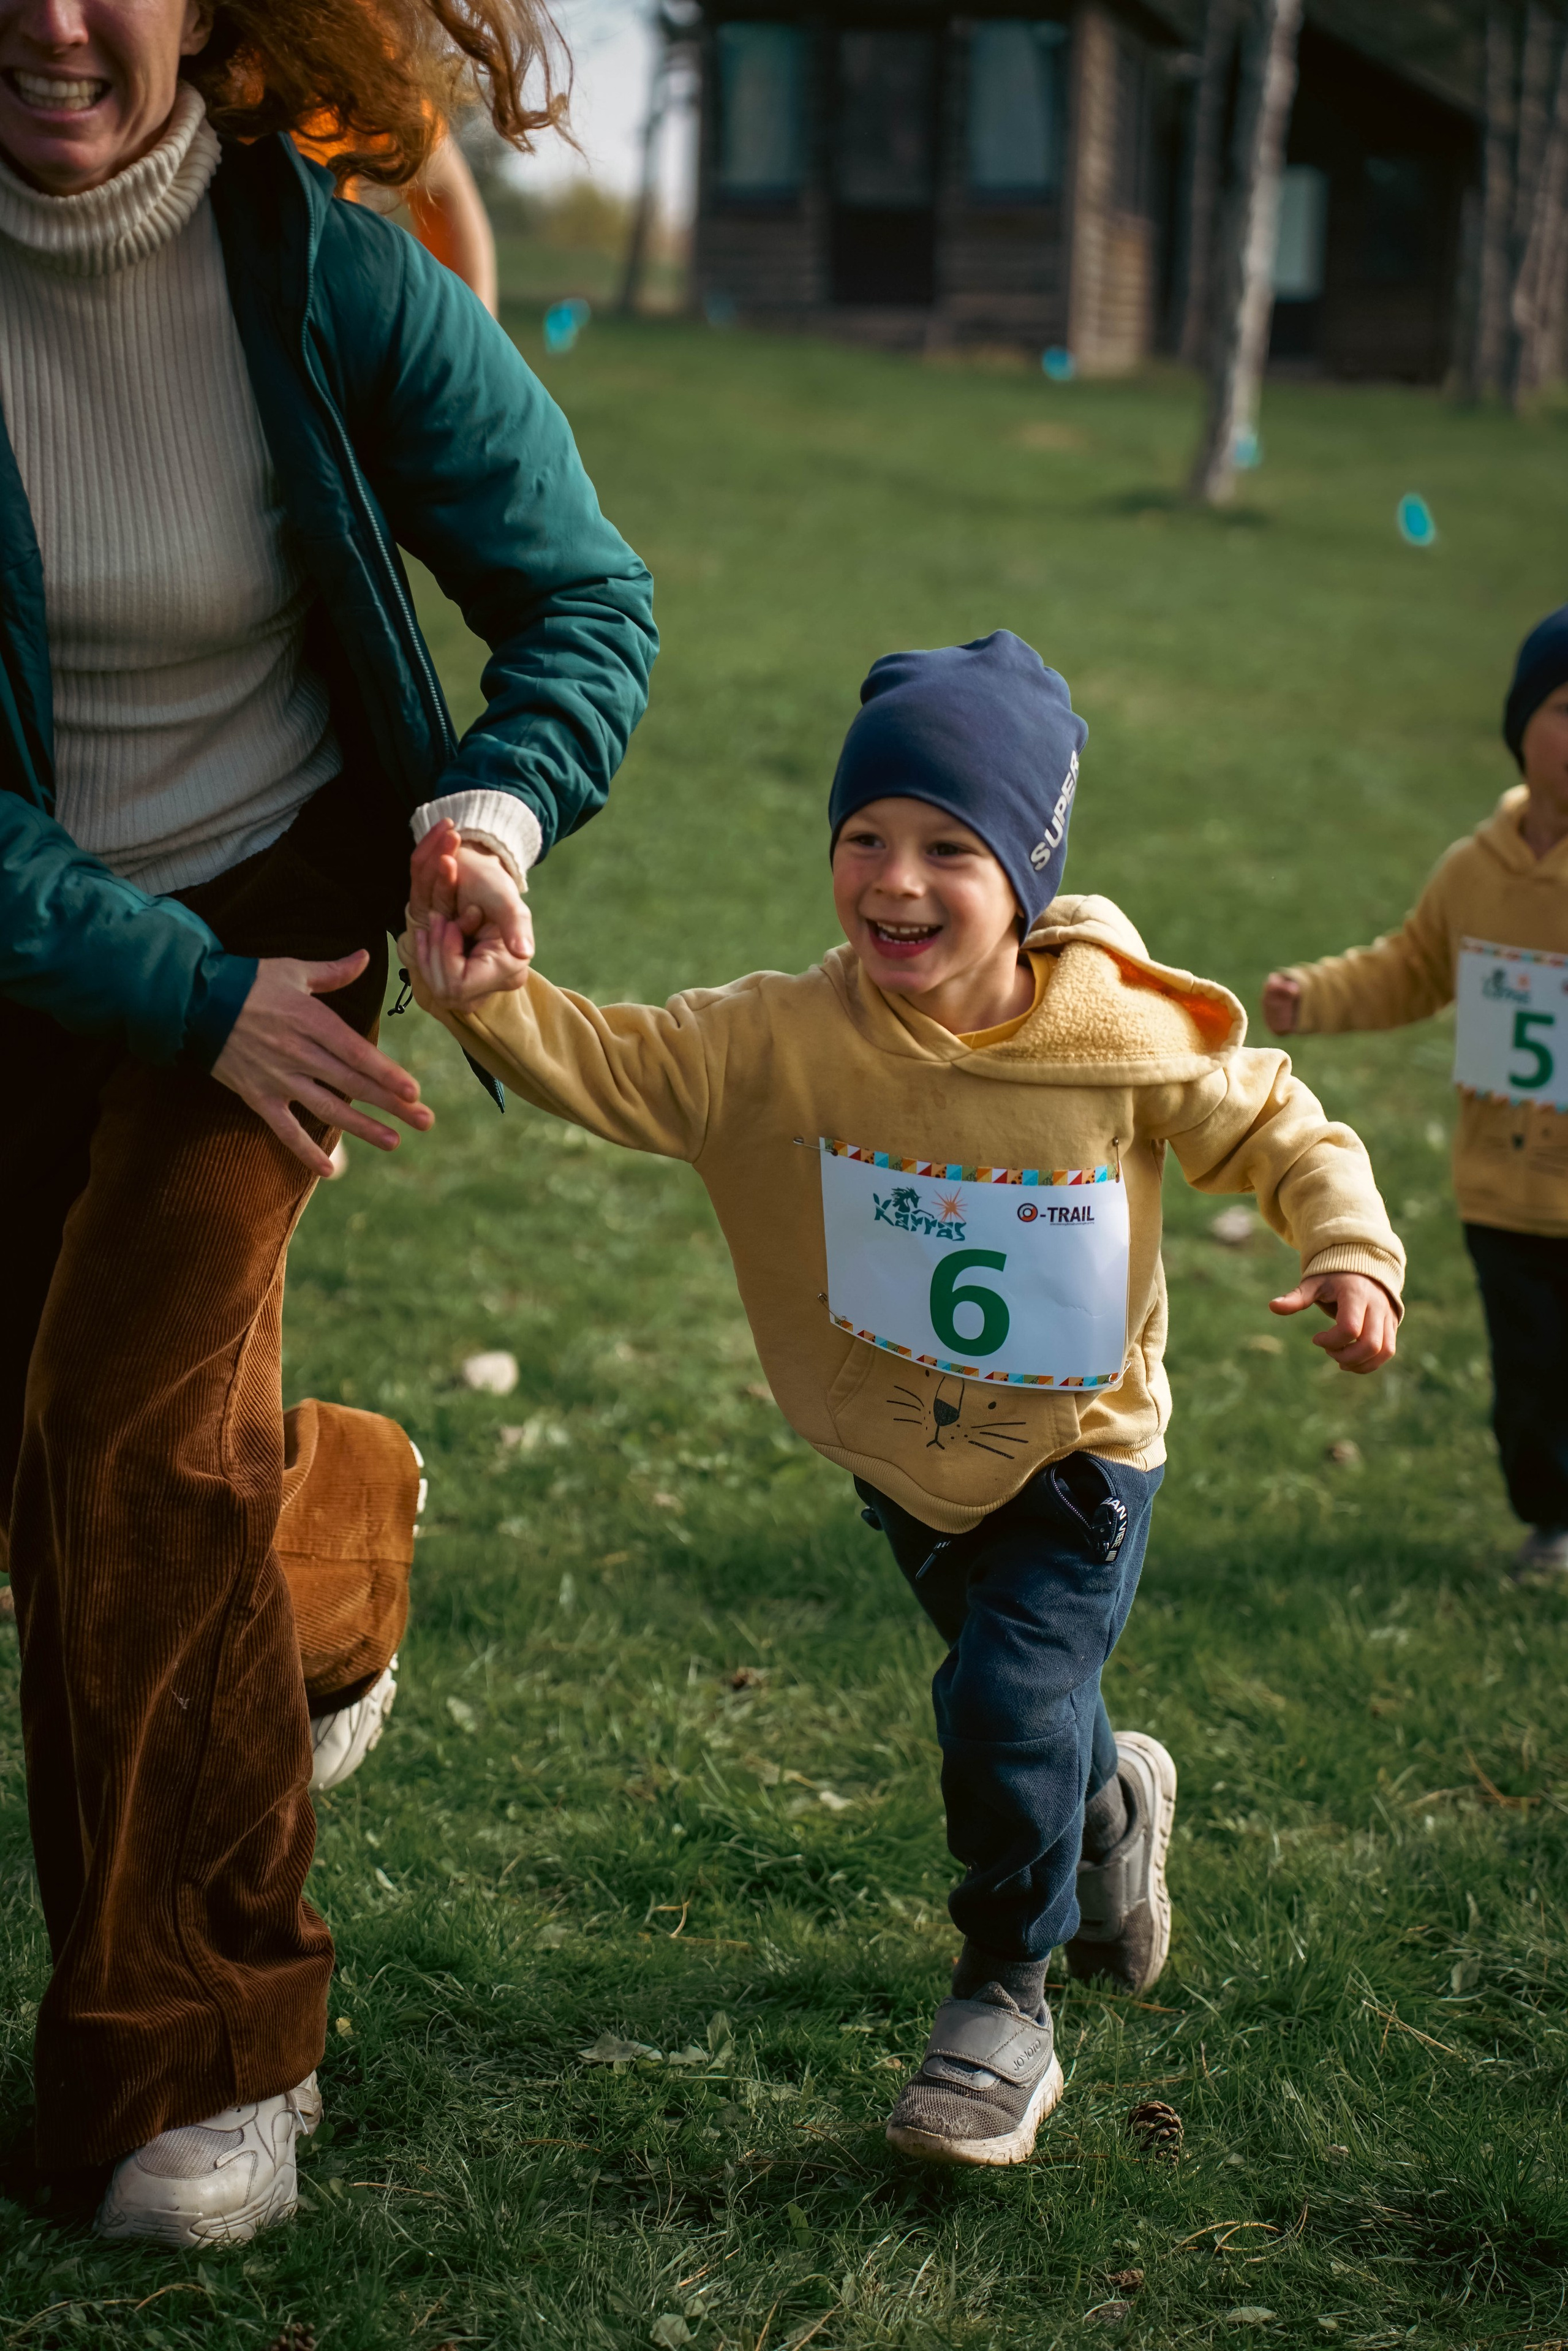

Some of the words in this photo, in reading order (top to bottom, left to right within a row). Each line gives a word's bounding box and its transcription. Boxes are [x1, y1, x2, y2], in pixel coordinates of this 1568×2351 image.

[1030, 750, 1079, 870] SUPER
[1509, 1012, 1555, 1089] 5
[930, 1248, 1010, 1357] 6
[1111, 1520, 1127, 1549] VIBE
